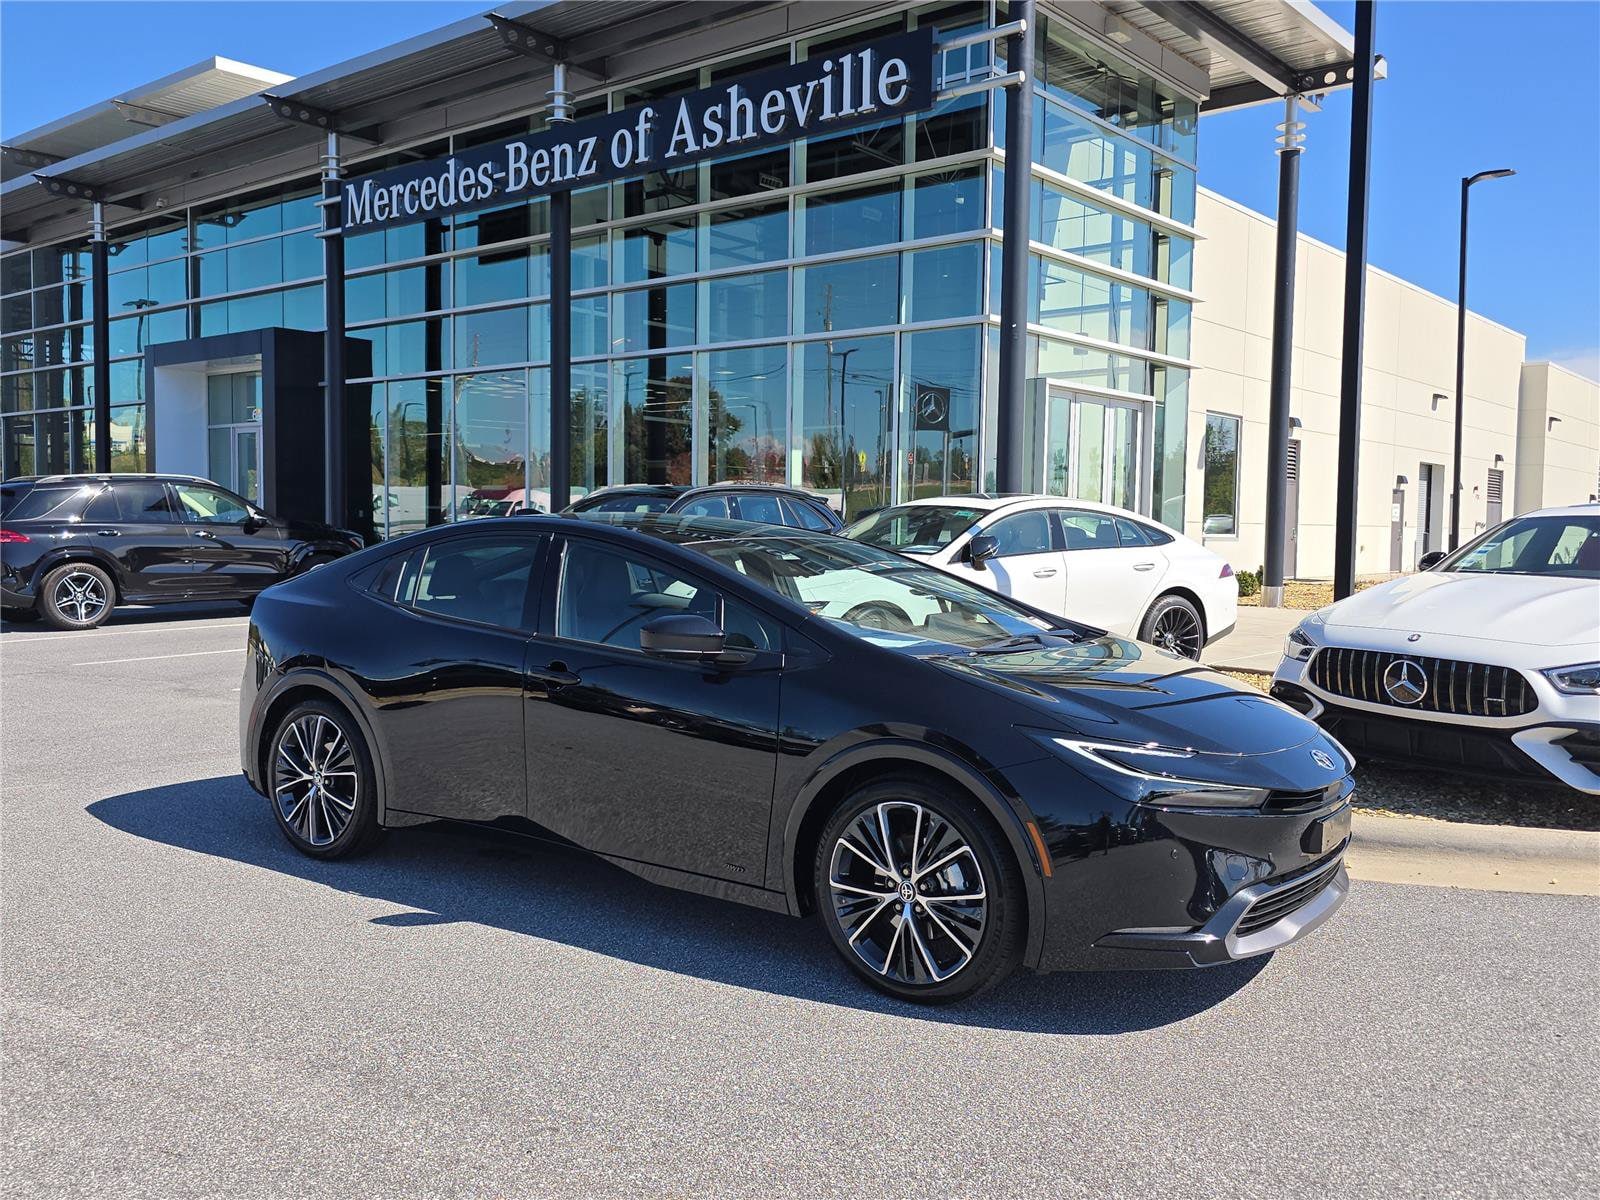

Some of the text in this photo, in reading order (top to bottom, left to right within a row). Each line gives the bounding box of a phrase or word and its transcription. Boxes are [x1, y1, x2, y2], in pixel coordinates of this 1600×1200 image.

[344, 47, 909, 229] Mercedes-Benz of Asheville
